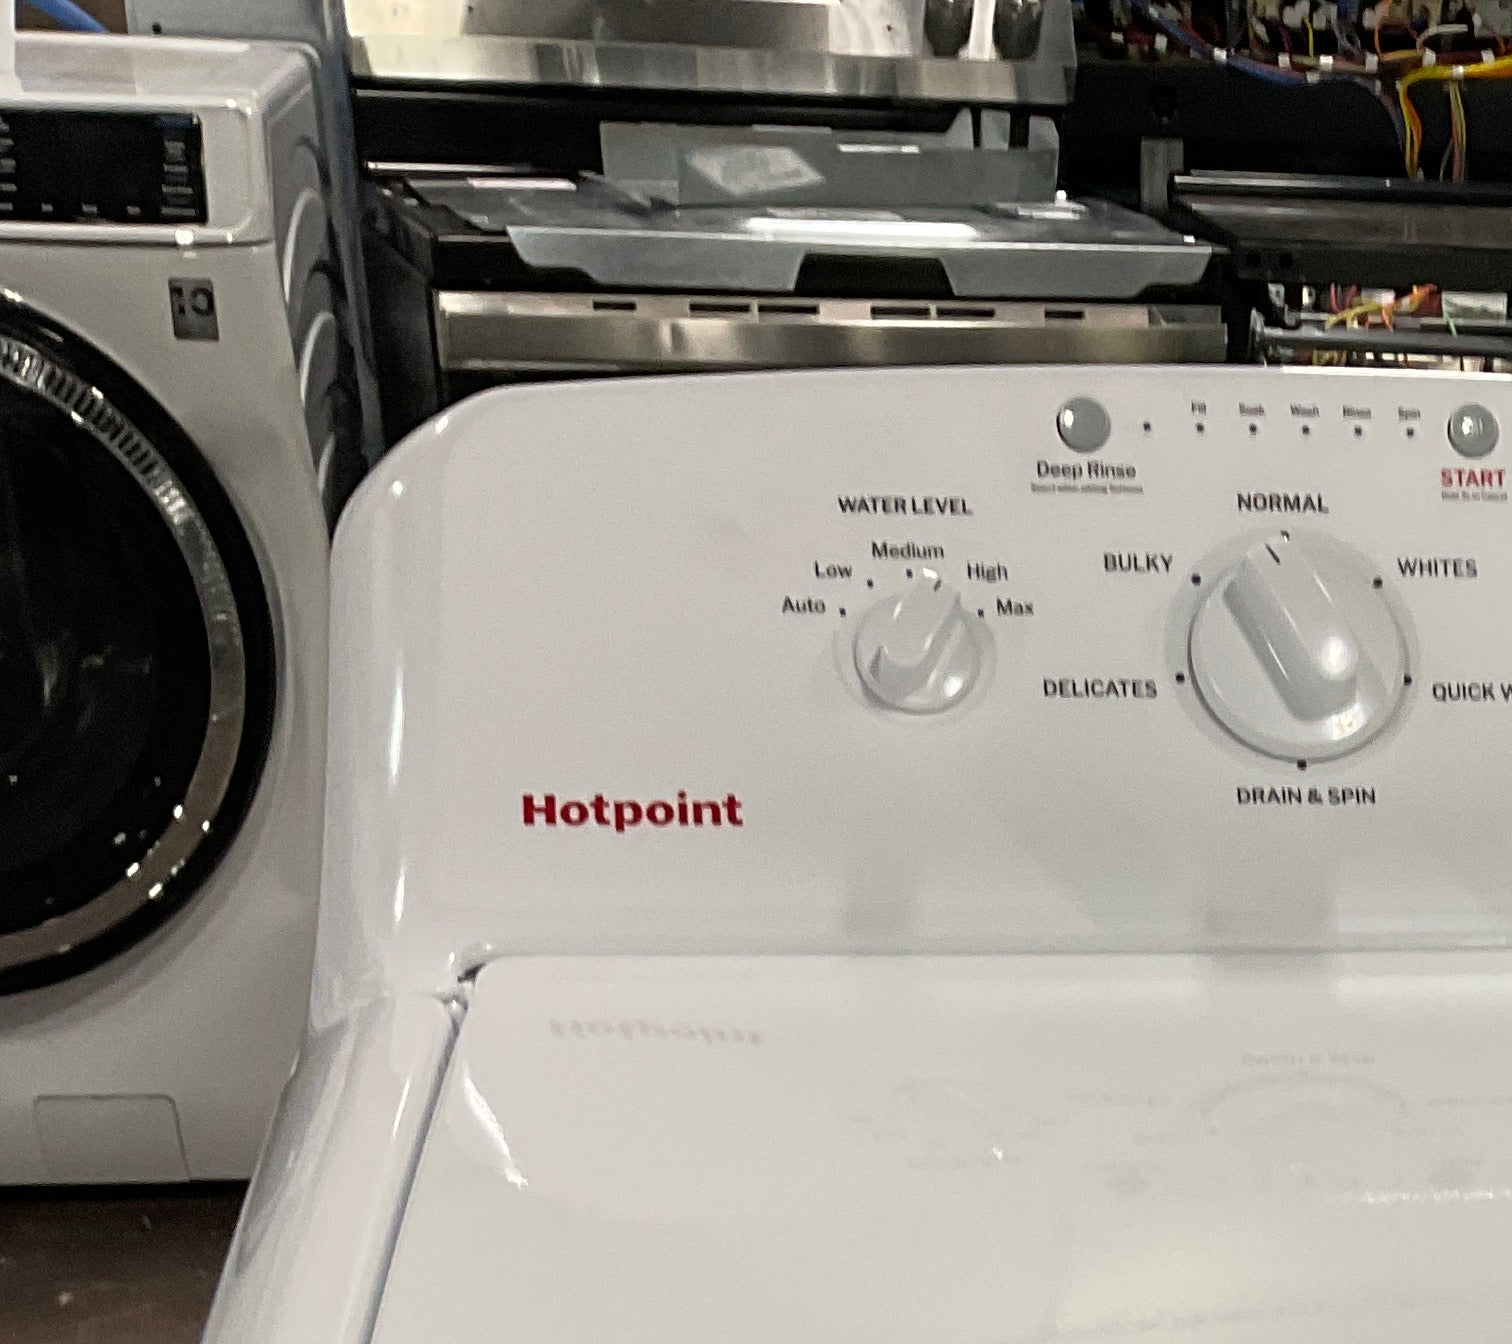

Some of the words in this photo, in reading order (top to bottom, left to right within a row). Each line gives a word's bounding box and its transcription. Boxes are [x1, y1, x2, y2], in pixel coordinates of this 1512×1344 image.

[1036, 460, 1083, 481] Deep
[1087, 461, 1137, 479] Rinse
[1440, 468, 1504, 488] START
[837, 496, 907, 515] WATER
[910, 497, 971, 516] LEVEL
[1237, 493, 1328, 514] NORMAL
[871, 541, 945, 559] Medium
[814, 561, 852, 579] Low
[966, 562, 1008, 583] High
[1103, 553, 1173, 573] BULKY
[1397, 557, 1478, 578] WHITES
[782, 596, 826, 614] Auto
[996, 598, 1034, 616] Max
[1043, 678, 1158, 699] DELICATES
[1432, 682, 1496, 703] QUICK
[1236, 787, 1303, 805] DRAIN
[1307, 787, 1324, 805] &
[1327, 787, 1376, 805] SPIN
[522, 790, 744, 834] Hotpoint
